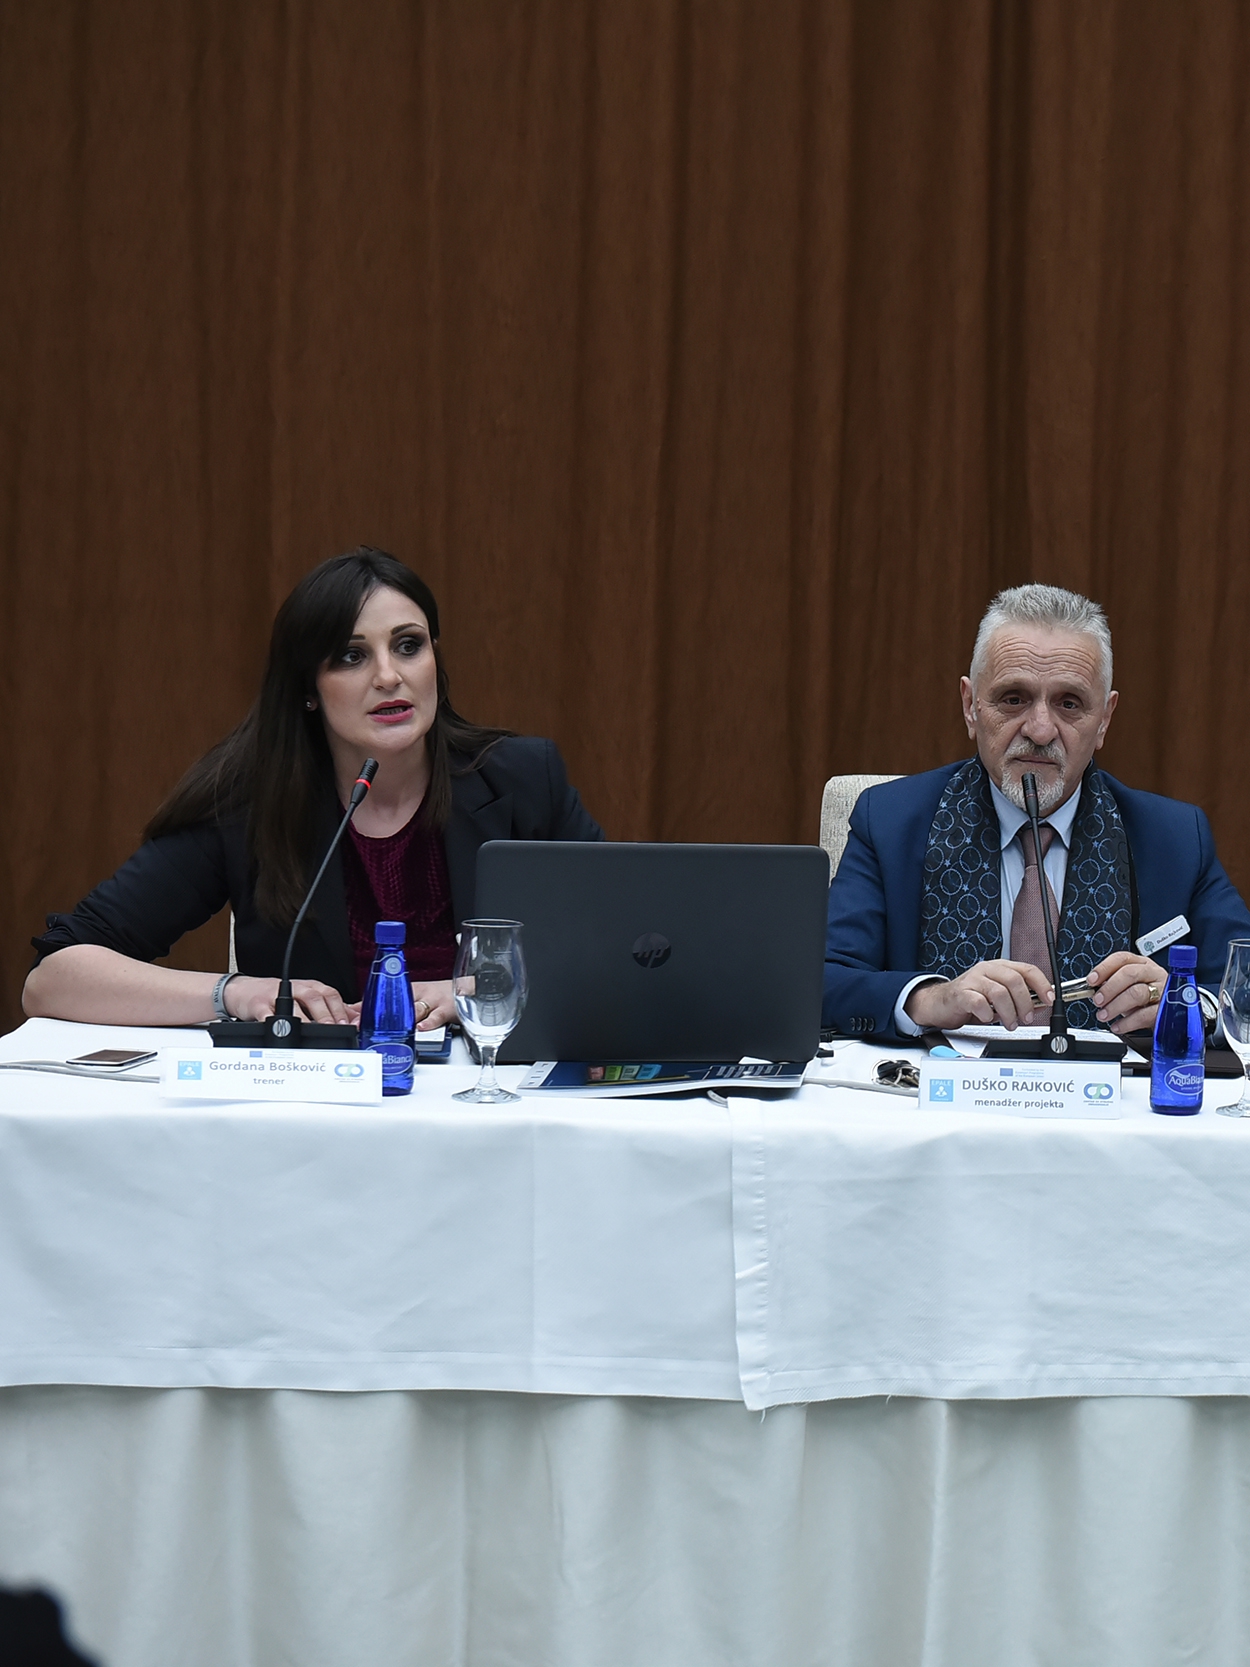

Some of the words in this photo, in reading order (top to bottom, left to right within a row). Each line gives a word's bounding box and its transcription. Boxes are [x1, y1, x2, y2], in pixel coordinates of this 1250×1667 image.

[209, 1061, 265, 1072] Gordana
[269, 1062, 326, 1073] Bošković
[253, 1077, 285, 1085] trener
[962, 1077, 1008, 1091] DUŠKO
[1012, 1079, 1075, 1093] RAJKOVIĆ
[974, 1097, 1021, 1107] menadžer
[1024, 1099, 1064, 1109] projekta
